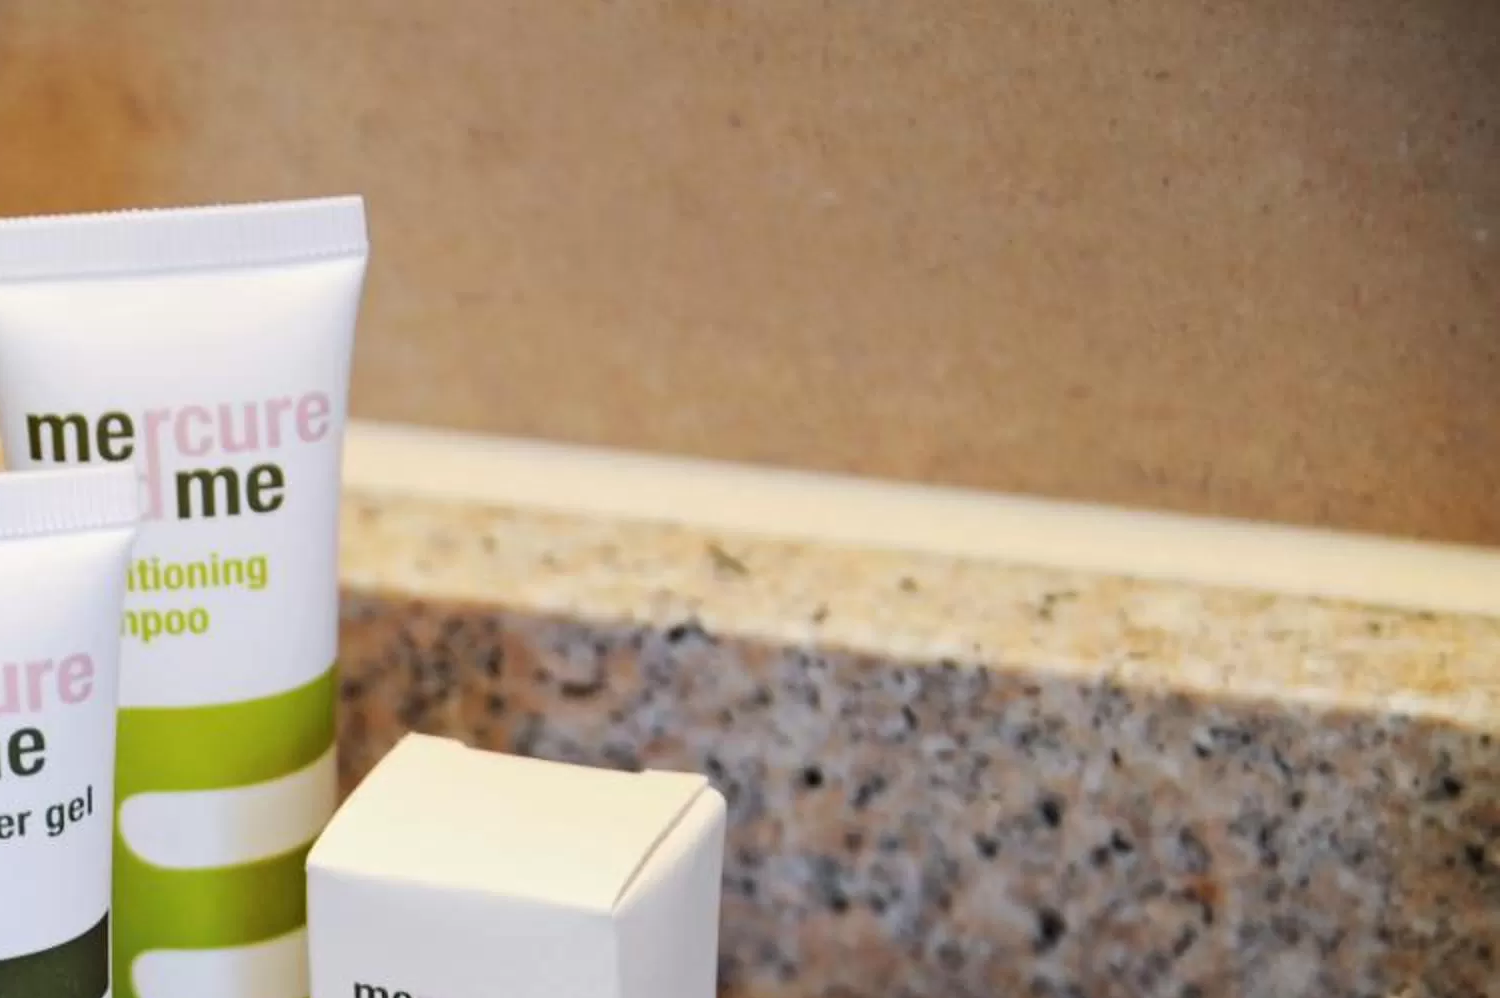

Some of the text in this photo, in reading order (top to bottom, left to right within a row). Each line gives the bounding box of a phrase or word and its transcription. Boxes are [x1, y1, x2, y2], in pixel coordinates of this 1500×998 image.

[26, 391, 331, 462] mercure
[175, 462, 285, 520] me
[45, 786, 95, 838] gel
